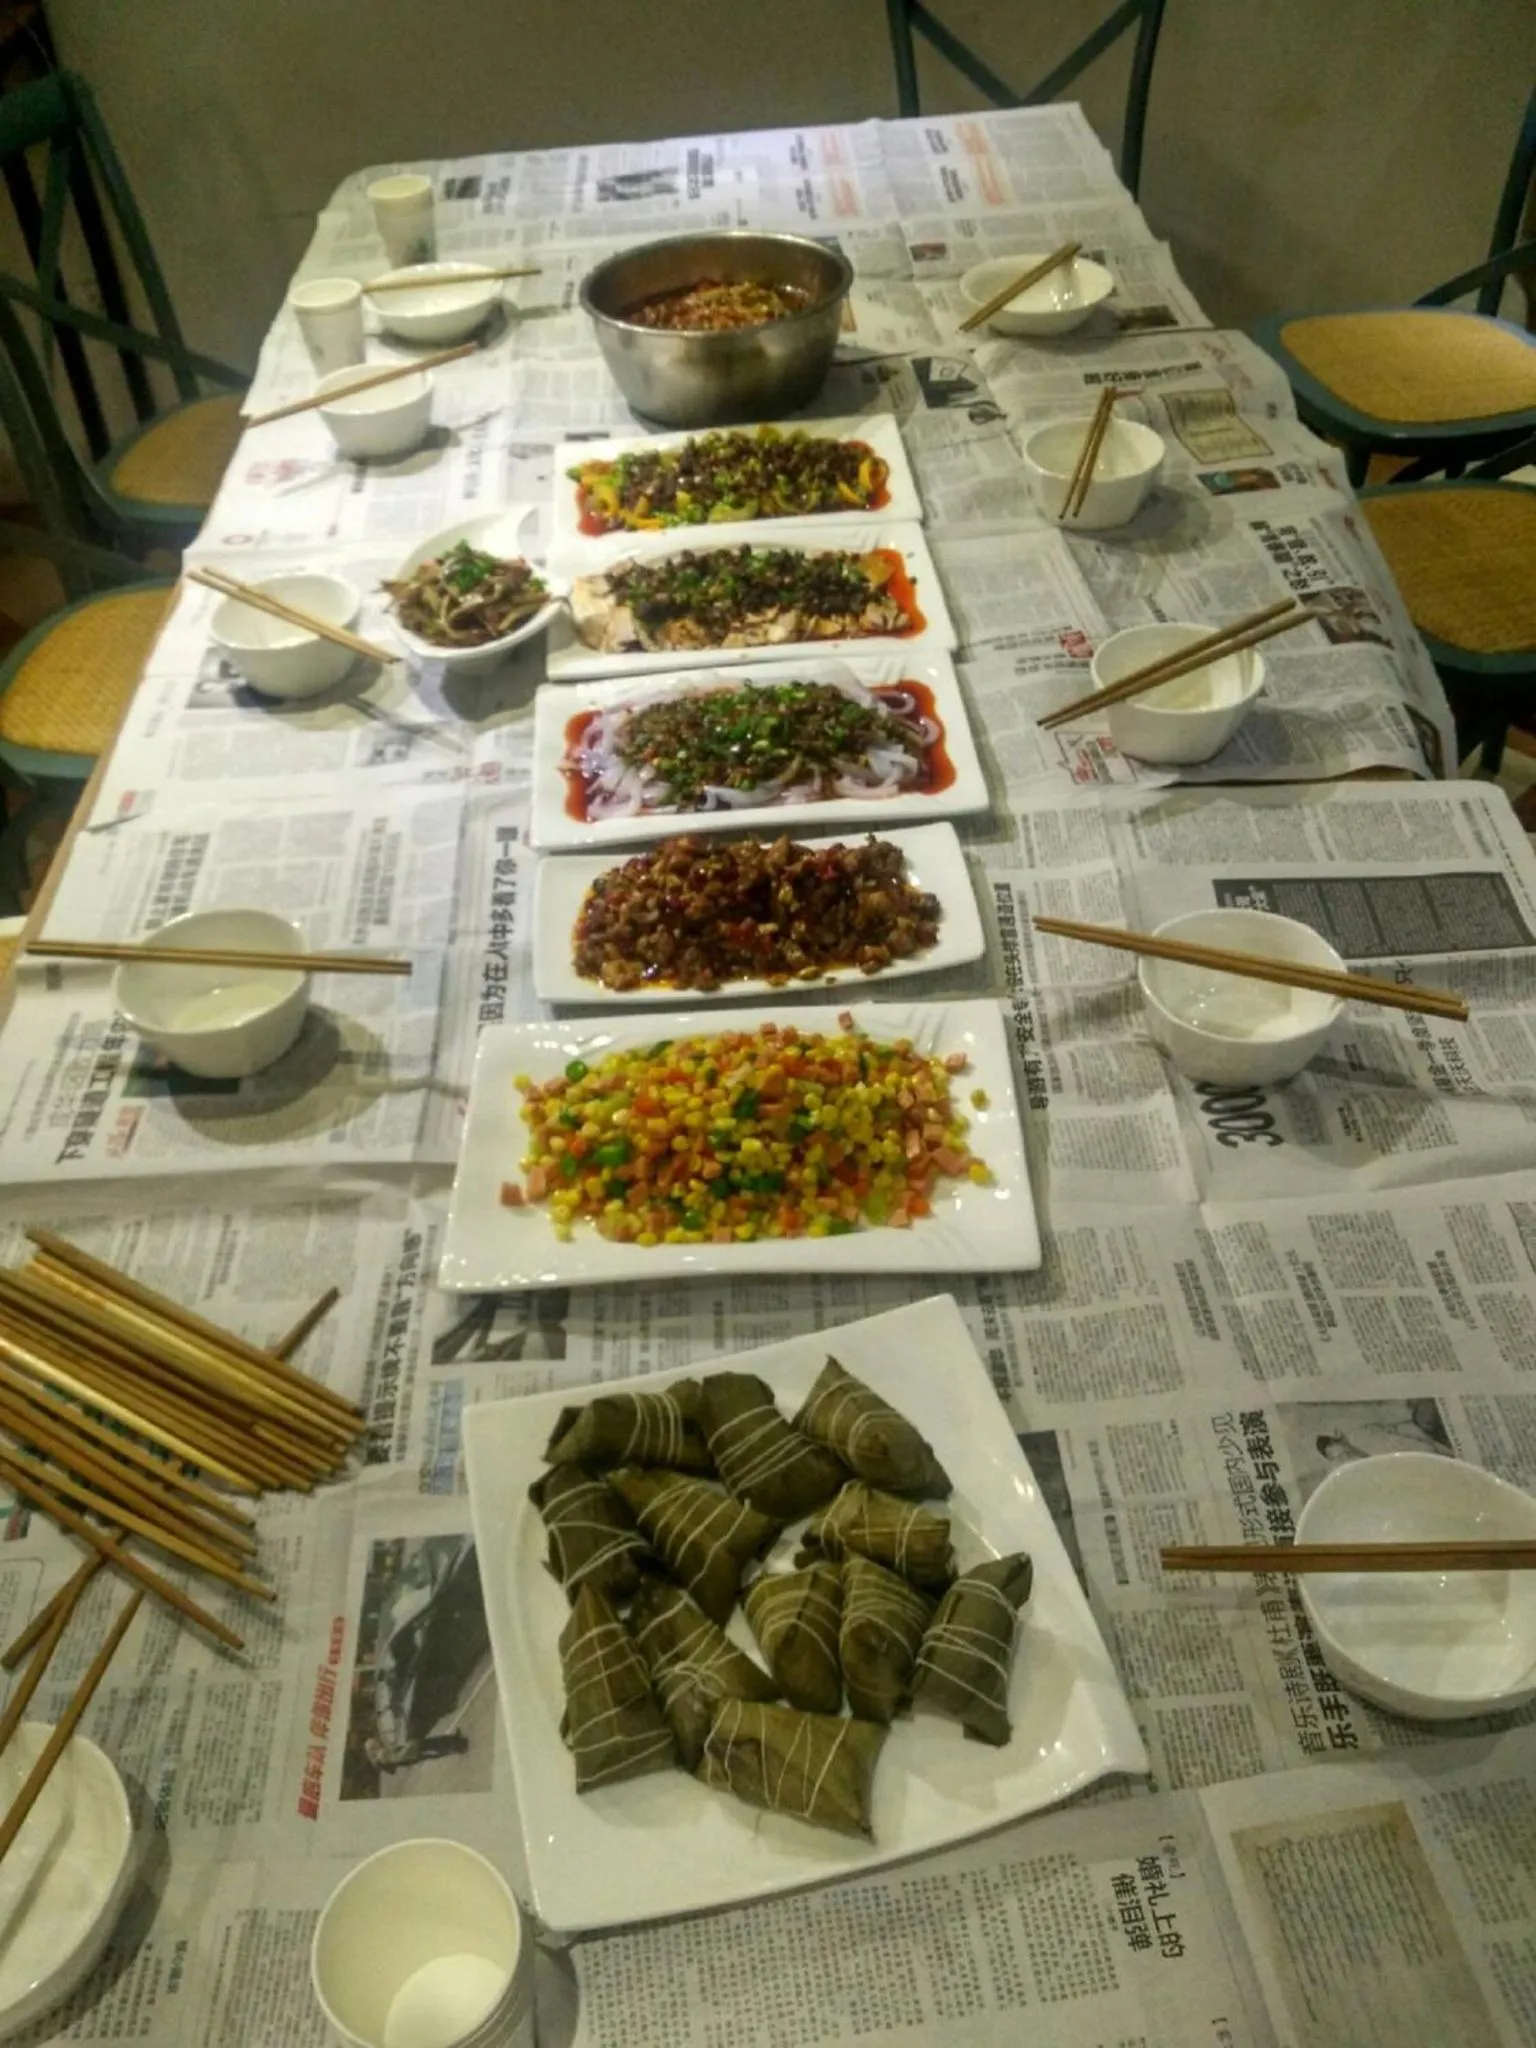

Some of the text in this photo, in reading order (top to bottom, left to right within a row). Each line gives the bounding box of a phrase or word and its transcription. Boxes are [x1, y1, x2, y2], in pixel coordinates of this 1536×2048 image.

[1211, 1410, 1326, 1756] 音乐诗剧《杜甫》表形式国内少见
[1111, 1873, 1153, 1952] 催泪弹
[1136, 1856, 1186, 1958] 婚礼上的
